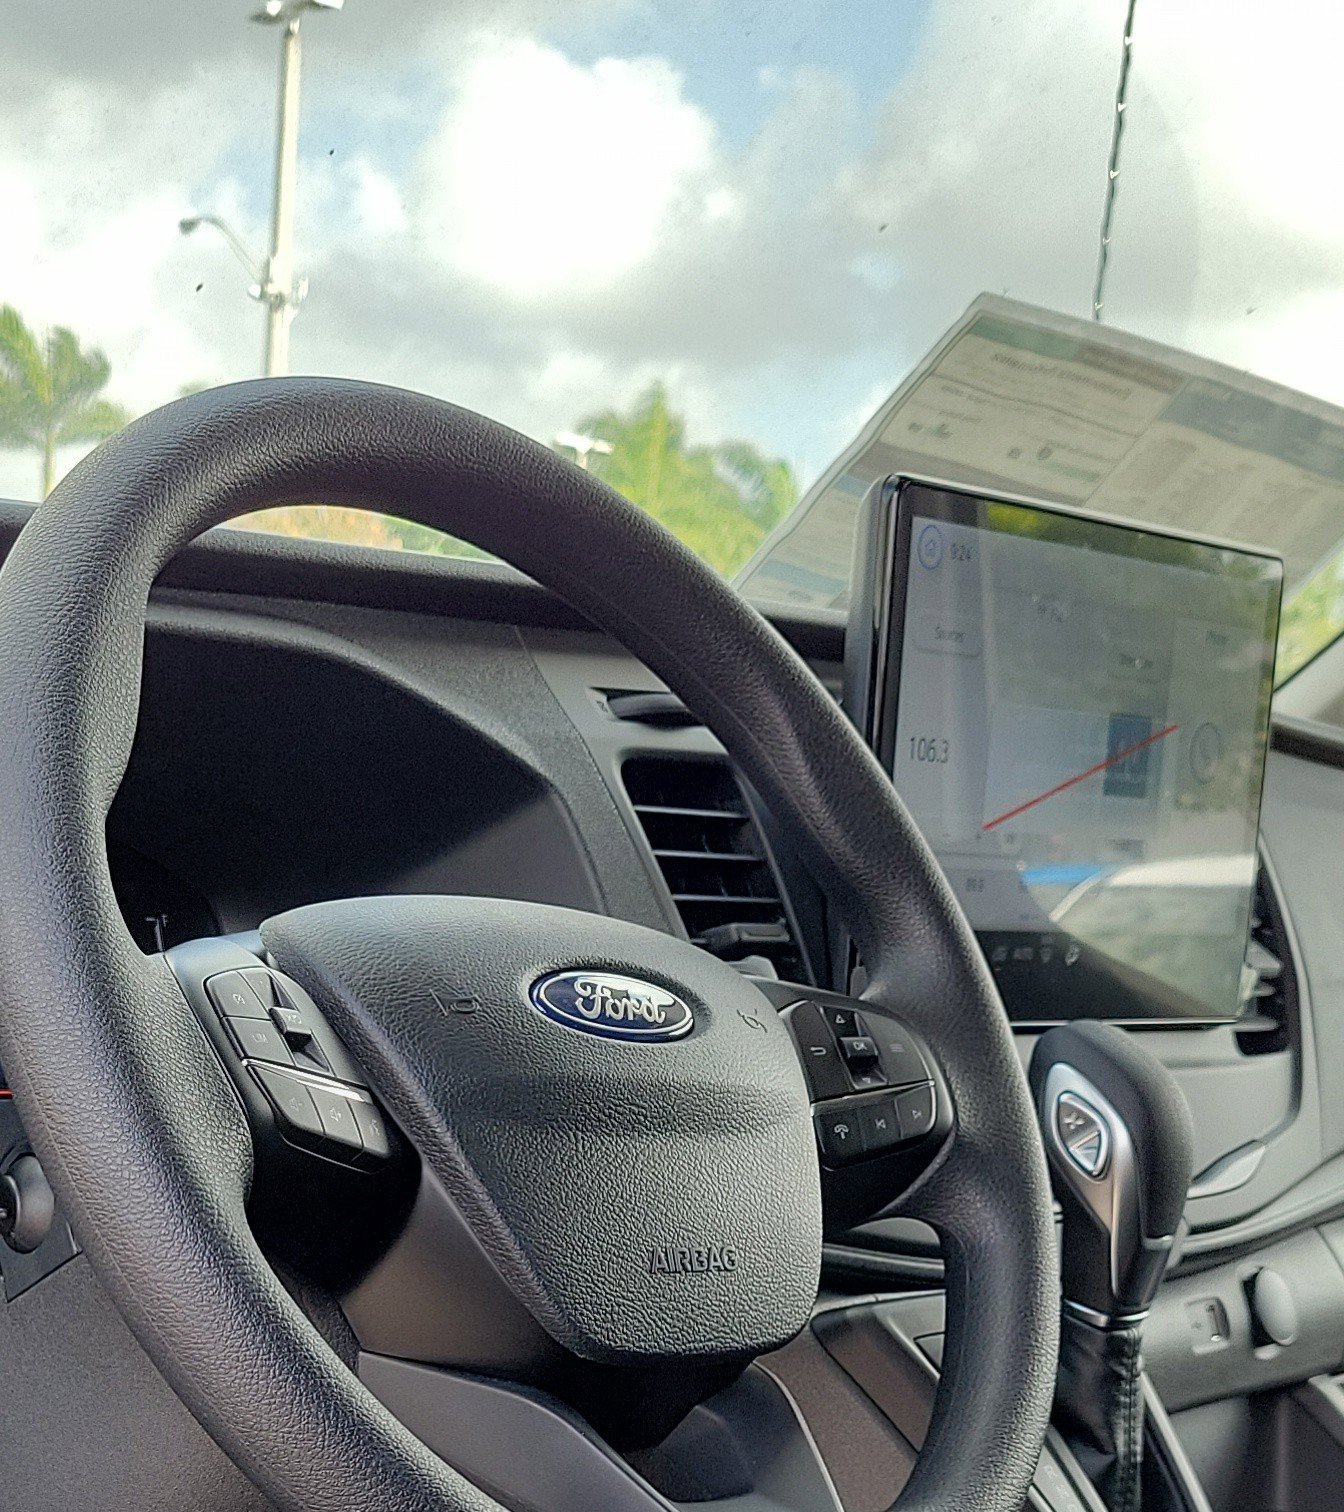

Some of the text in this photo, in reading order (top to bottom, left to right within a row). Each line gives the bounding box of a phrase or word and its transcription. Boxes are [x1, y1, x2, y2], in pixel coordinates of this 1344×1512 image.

[909, 736, 949, 764] 106.3
[573, 978, 672, 1024] Ford
[650, 1245, 738, 1274] AIRBAG
